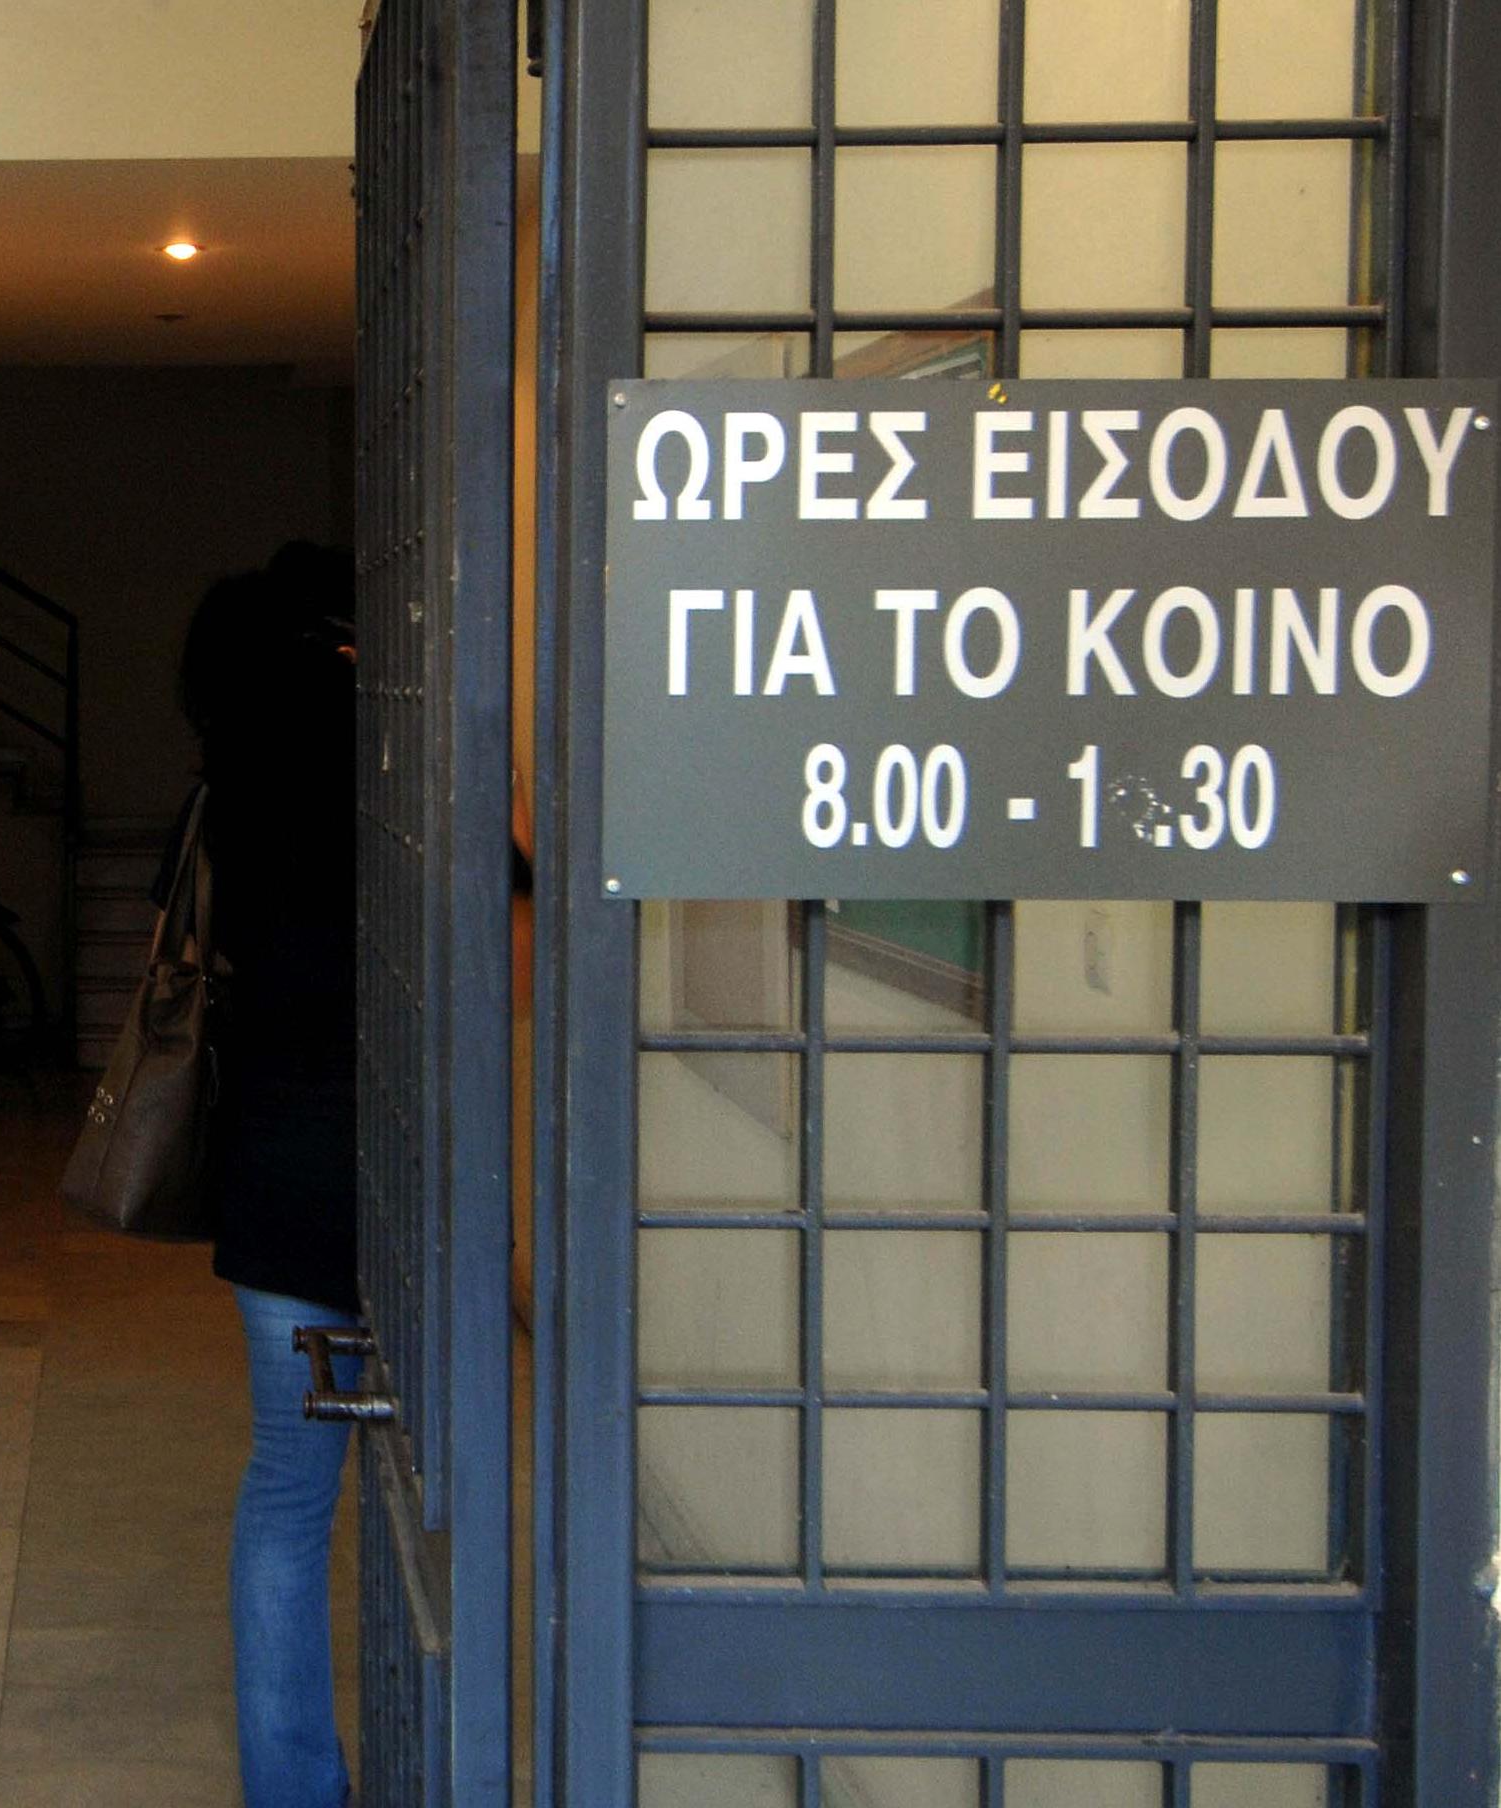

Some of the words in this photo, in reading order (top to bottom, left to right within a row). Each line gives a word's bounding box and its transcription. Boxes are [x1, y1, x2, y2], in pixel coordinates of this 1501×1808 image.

[633, 410, 927, 520] ΩΡΕΣ
[973, 406, 1472, 521] ΕΙΣΟΔΟΥ
[668, 590, 835, 695] ΓΙΑ
[875, 587, 1020, 698] ΤΟ
[1068, 585, 1430, 697] ΚΟΙΝΟ
[802, 744, 966, 848] 8.00
[1009, 799, 1034, 819] -
[1069, 745, 1275, 849] 1.30
